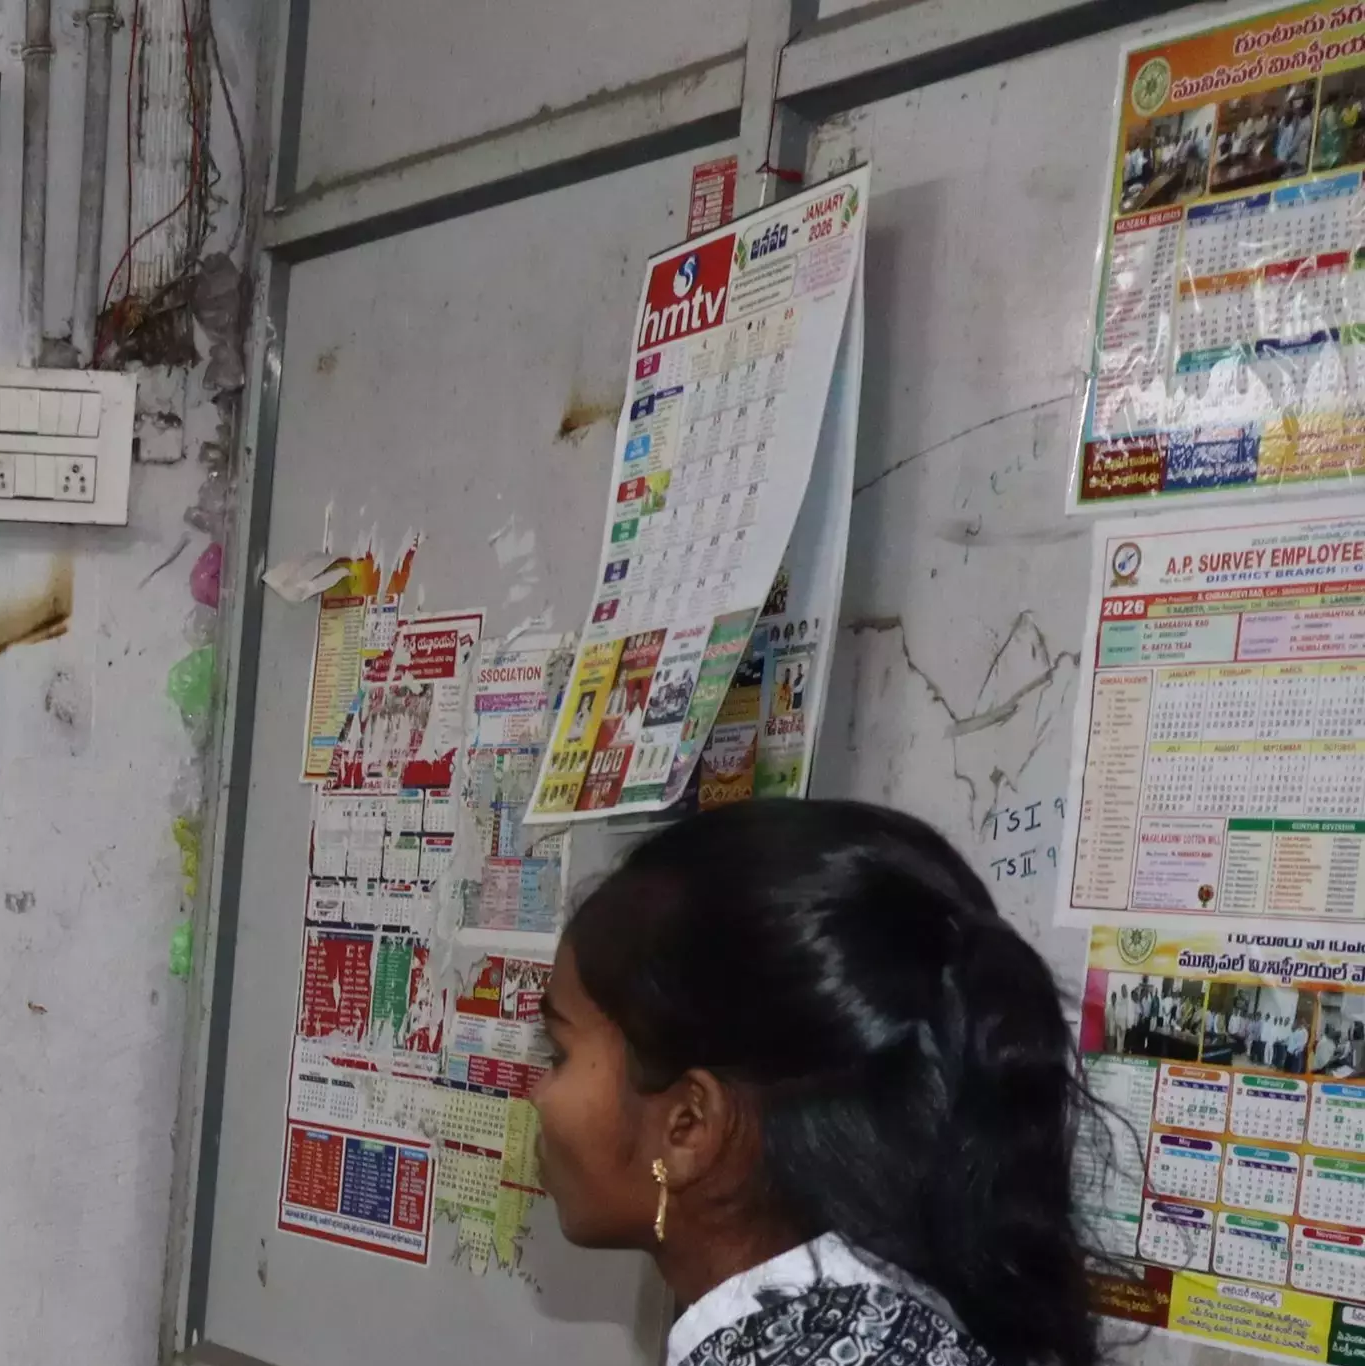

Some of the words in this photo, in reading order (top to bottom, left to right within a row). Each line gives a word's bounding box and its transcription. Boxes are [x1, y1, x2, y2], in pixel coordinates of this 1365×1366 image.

[1235, 13, 1325, 55] గుంటూరు
[802, 192, 846, 223] JANUARY
[807, 218, 834, 242] 2026
[639, 284, 726, 348] hmtv
[1166, 553, 1193, 576] A.P.
[1198, 548, 1267, 574] SURVEY
[1270, 541, 1364, 568] EMPLOYEE
[1206, 571, 1270, 583] DISTRICT
[1275, 565, 1336, 578] BRANCH
[1104, 599, 1145, 617] 2026
[478, 667, 541, 683] SSOCIATION
[1263, 742, 1302, 752] SEPTEMBER
[1323, 742, 1356, 752] OCTOBER
[1178, 951, 1245, 974] మున్సిపల్
[1256, 1077, 1286, 1089] February
[1316, 1231, 1351, 1242] November
